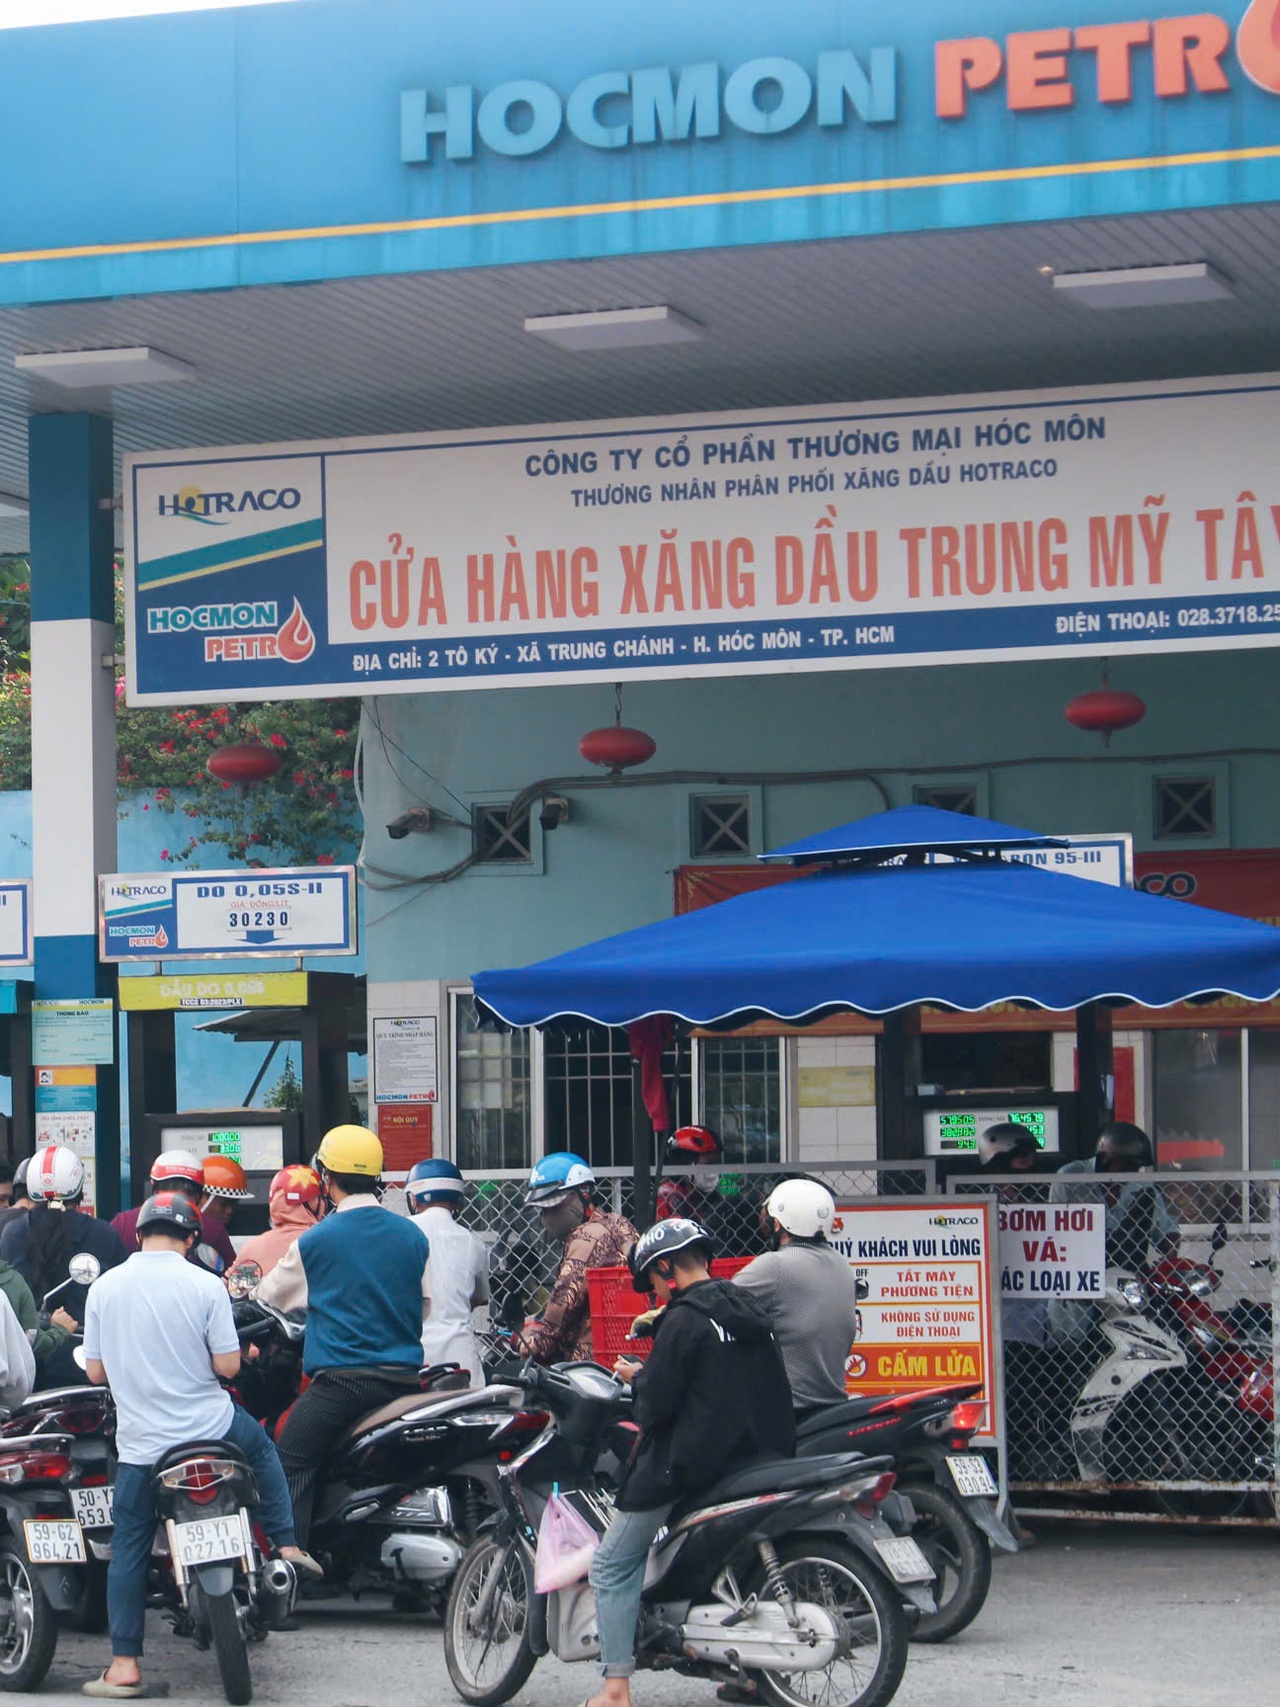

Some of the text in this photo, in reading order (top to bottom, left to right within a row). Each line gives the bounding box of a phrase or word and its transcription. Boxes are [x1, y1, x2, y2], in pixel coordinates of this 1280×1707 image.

[400, 46, 897, 163] HOCMON
[525, 410, 1106, 478] CÔNG TY CỔ PHẦN THƯƠNG MẠI HÓC MÔN
[571, 458, 1058, 508] THƯƠNG NHÂN PHÂN PHỐI XĂNG DẦU HOTRACO
[159, 487, 301, 516] HOTRACO
[349, 532, 448, 631] CỬA
[467, 534, 600, 624] HÀNG
[619, 528, 756, 615] XĂNG
[775, 504, 879, 607] DẦU
[899, 517, 1070, 599] TRUNG
[1089, 493, 1170, 588] MỸ
[147, 600, 278, 634] HOCMON
[1056, 603, 1280, 639] ĐIỆN THOẠI: 028.3718.25
[353, 650, 382, 675] ĐỊA
[388, 645, 422, 669] CHỈ:
[428, 648, 439, 667] 2
[445, 644, 468, 667] TÔ
[474, 641, 498, 665] KÝ
[517, 639, 542, 663] XÃ
[548, 639, 607, 662] TRUNG
[613, 633, 674, 658] CHÁNH
[693, 634, 711, 653] H.
[718, 628, 756, 651] HÓC
[762, 626, 801, 649] MÔN
[821, 629, 848, 647] TP.
[855, 626, 895, 645] HCM
[1055, 850, 1102, 864] 95-III
[197, 885, 225, 898] DO
[229, 911, 289, 927] 30230
[108, 925, 155, 937] HOCMON
[929, 1216, 979, 1227] HOTRACO
[1054, 1207, 1094, 1232] HƠI
[829, 1234, 981, 1258] UÝ KHÁCH VUI LÒNG
[1022, 1235, 1067, 1262] VÁ:
[855, 1268, 869, 1278] OFF
[897, 1267, 956, 1283] TẮT MÁY
[1001, 1265, 1100, 1296] ÁC LOẠI XE
[880, 1283, 974, 1299] PHƯƠNG TIỆN
[881, 1307, 975, 1325] KHÔNG SỬ DỤNG
[896, 1325, 961, 1340] ĐIỆN THOẠI
[877, 1350, 977, 1378] CẤM LỬA
[33, 1523, 76, 1541] 59-G2
[185, 1521, 231, 1543] 59-Y1
[34, 1542, 82, 1561] 964.21
